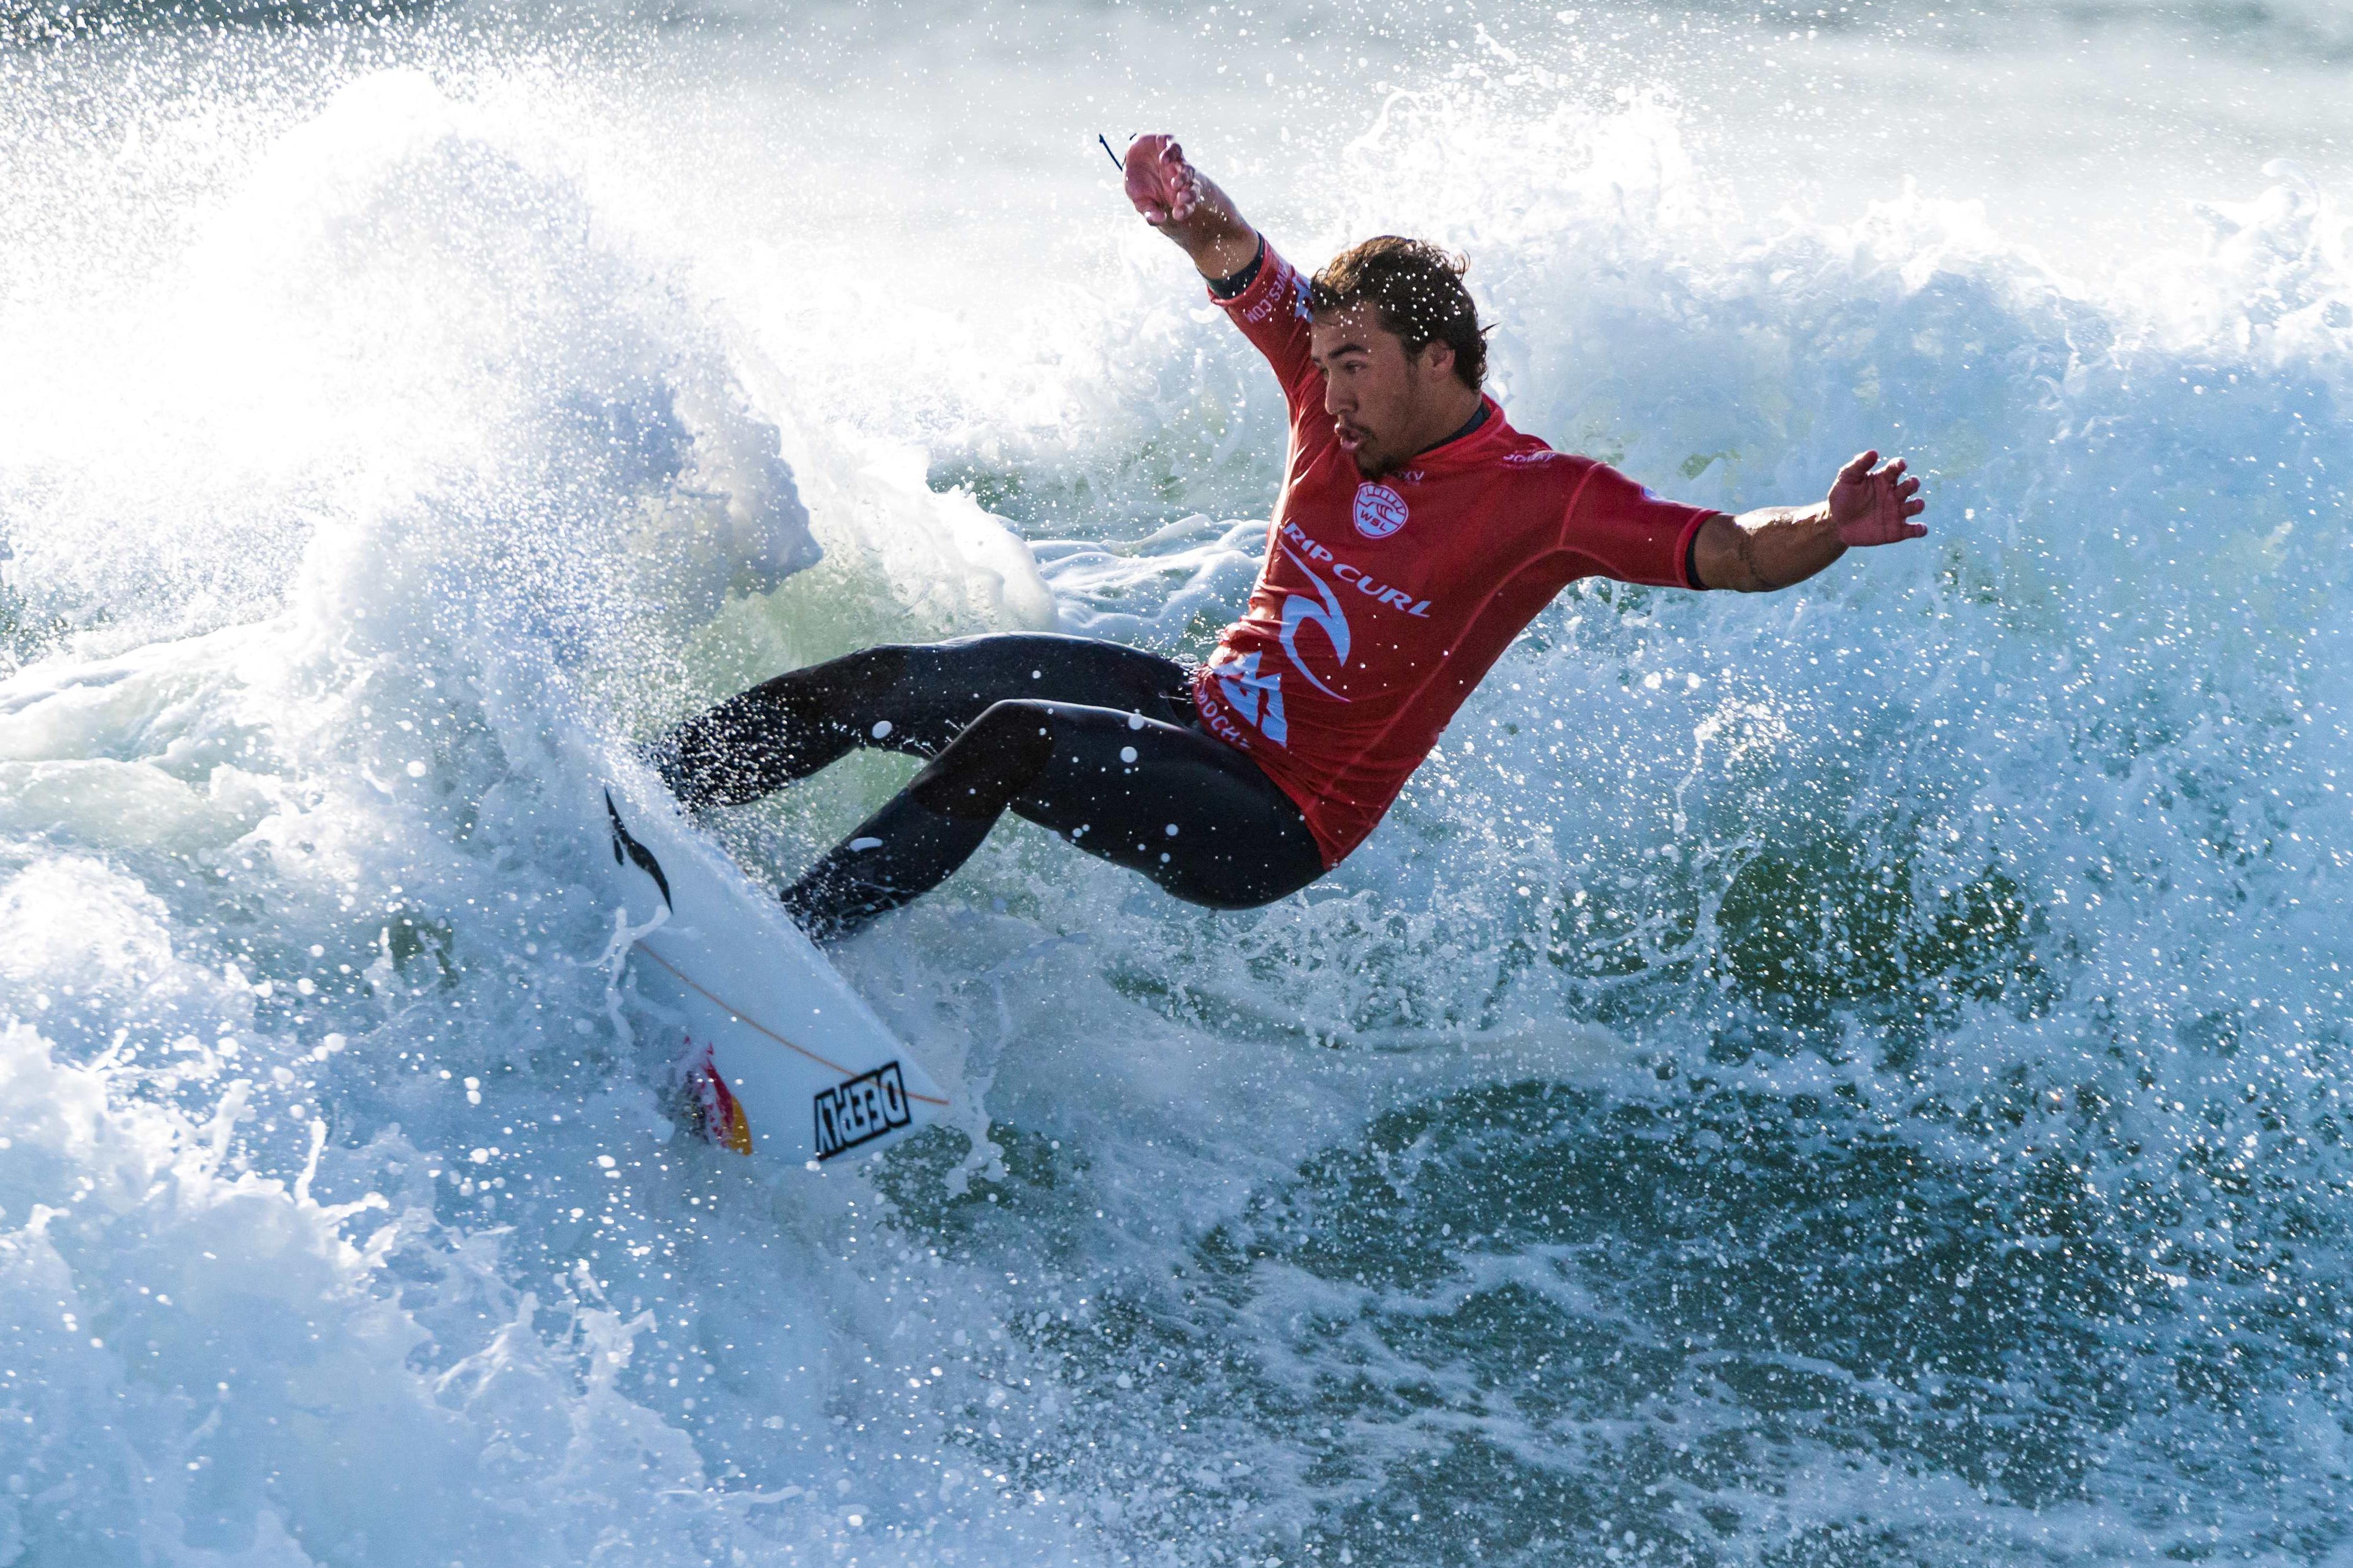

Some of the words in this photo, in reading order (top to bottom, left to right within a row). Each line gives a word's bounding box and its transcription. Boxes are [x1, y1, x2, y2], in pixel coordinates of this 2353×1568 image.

[1360, 509, 1387, 531] WSL
[1283, 522, 1333, 562] RIP
[1333, 563, 1431, 618] CURL
[814, 1060, 912, 1161] DEEPLY
